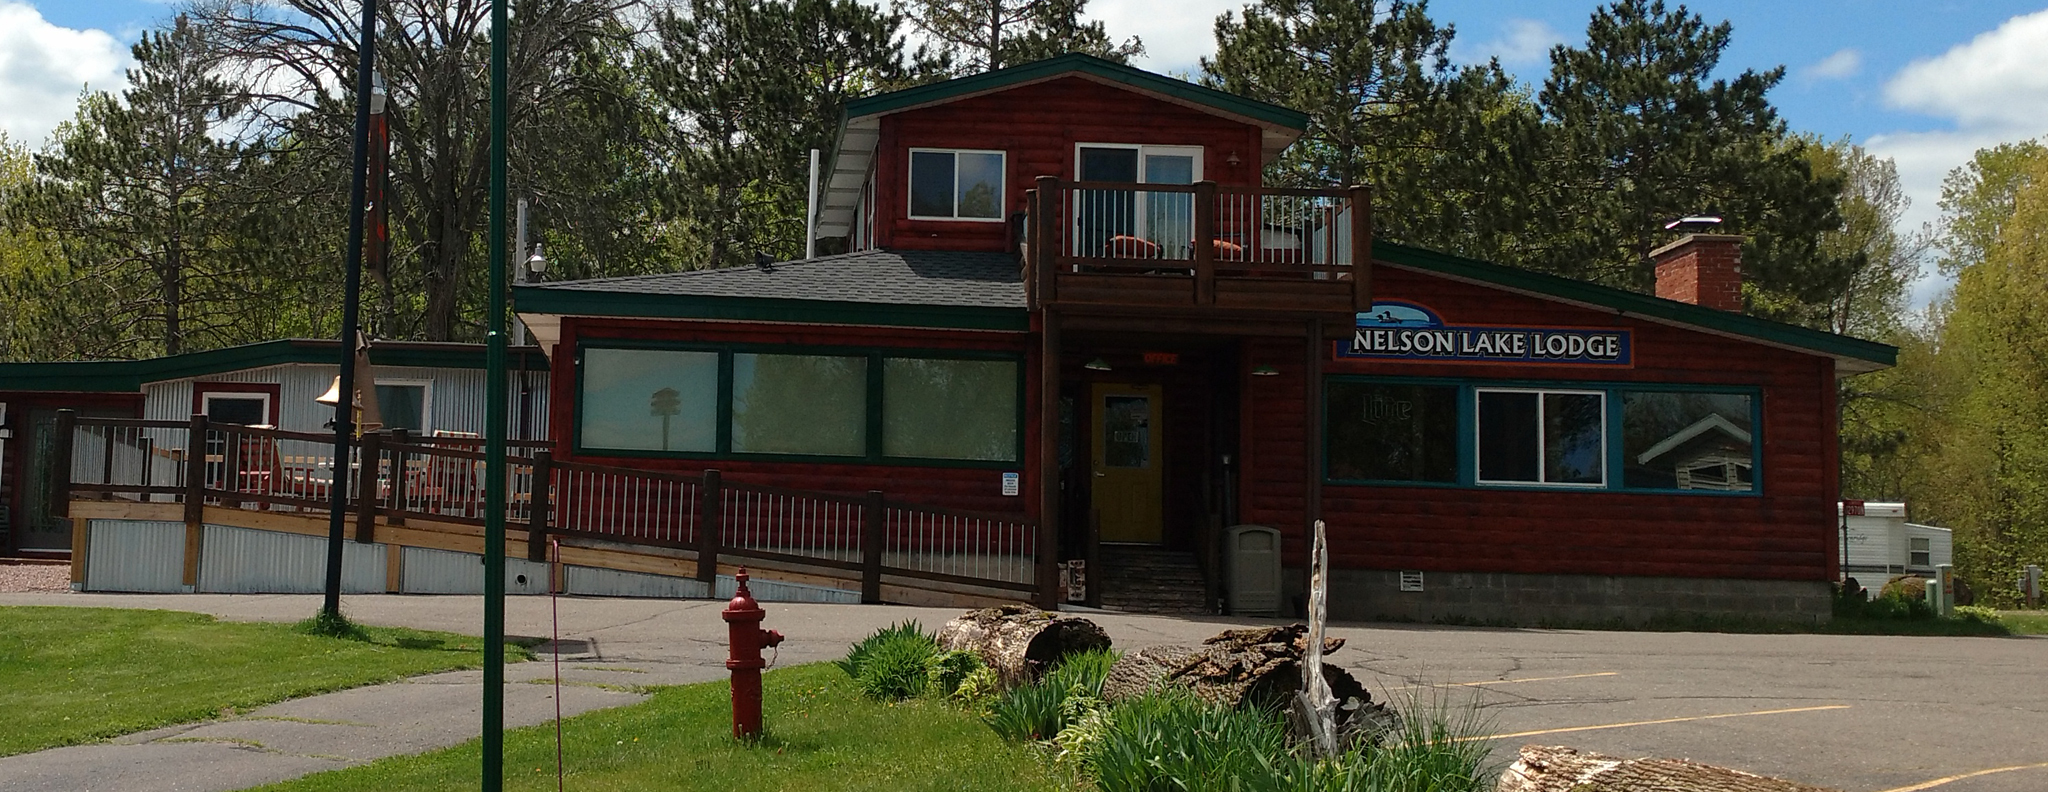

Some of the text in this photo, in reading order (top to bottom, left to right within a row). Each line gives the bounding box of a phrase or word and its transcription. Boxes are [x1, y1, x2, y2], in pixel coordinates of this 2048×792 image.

[1353, 329, 1621, 358] NELSON LAKE LODGE
[1144, 352, 1178, 364] OFFICE
